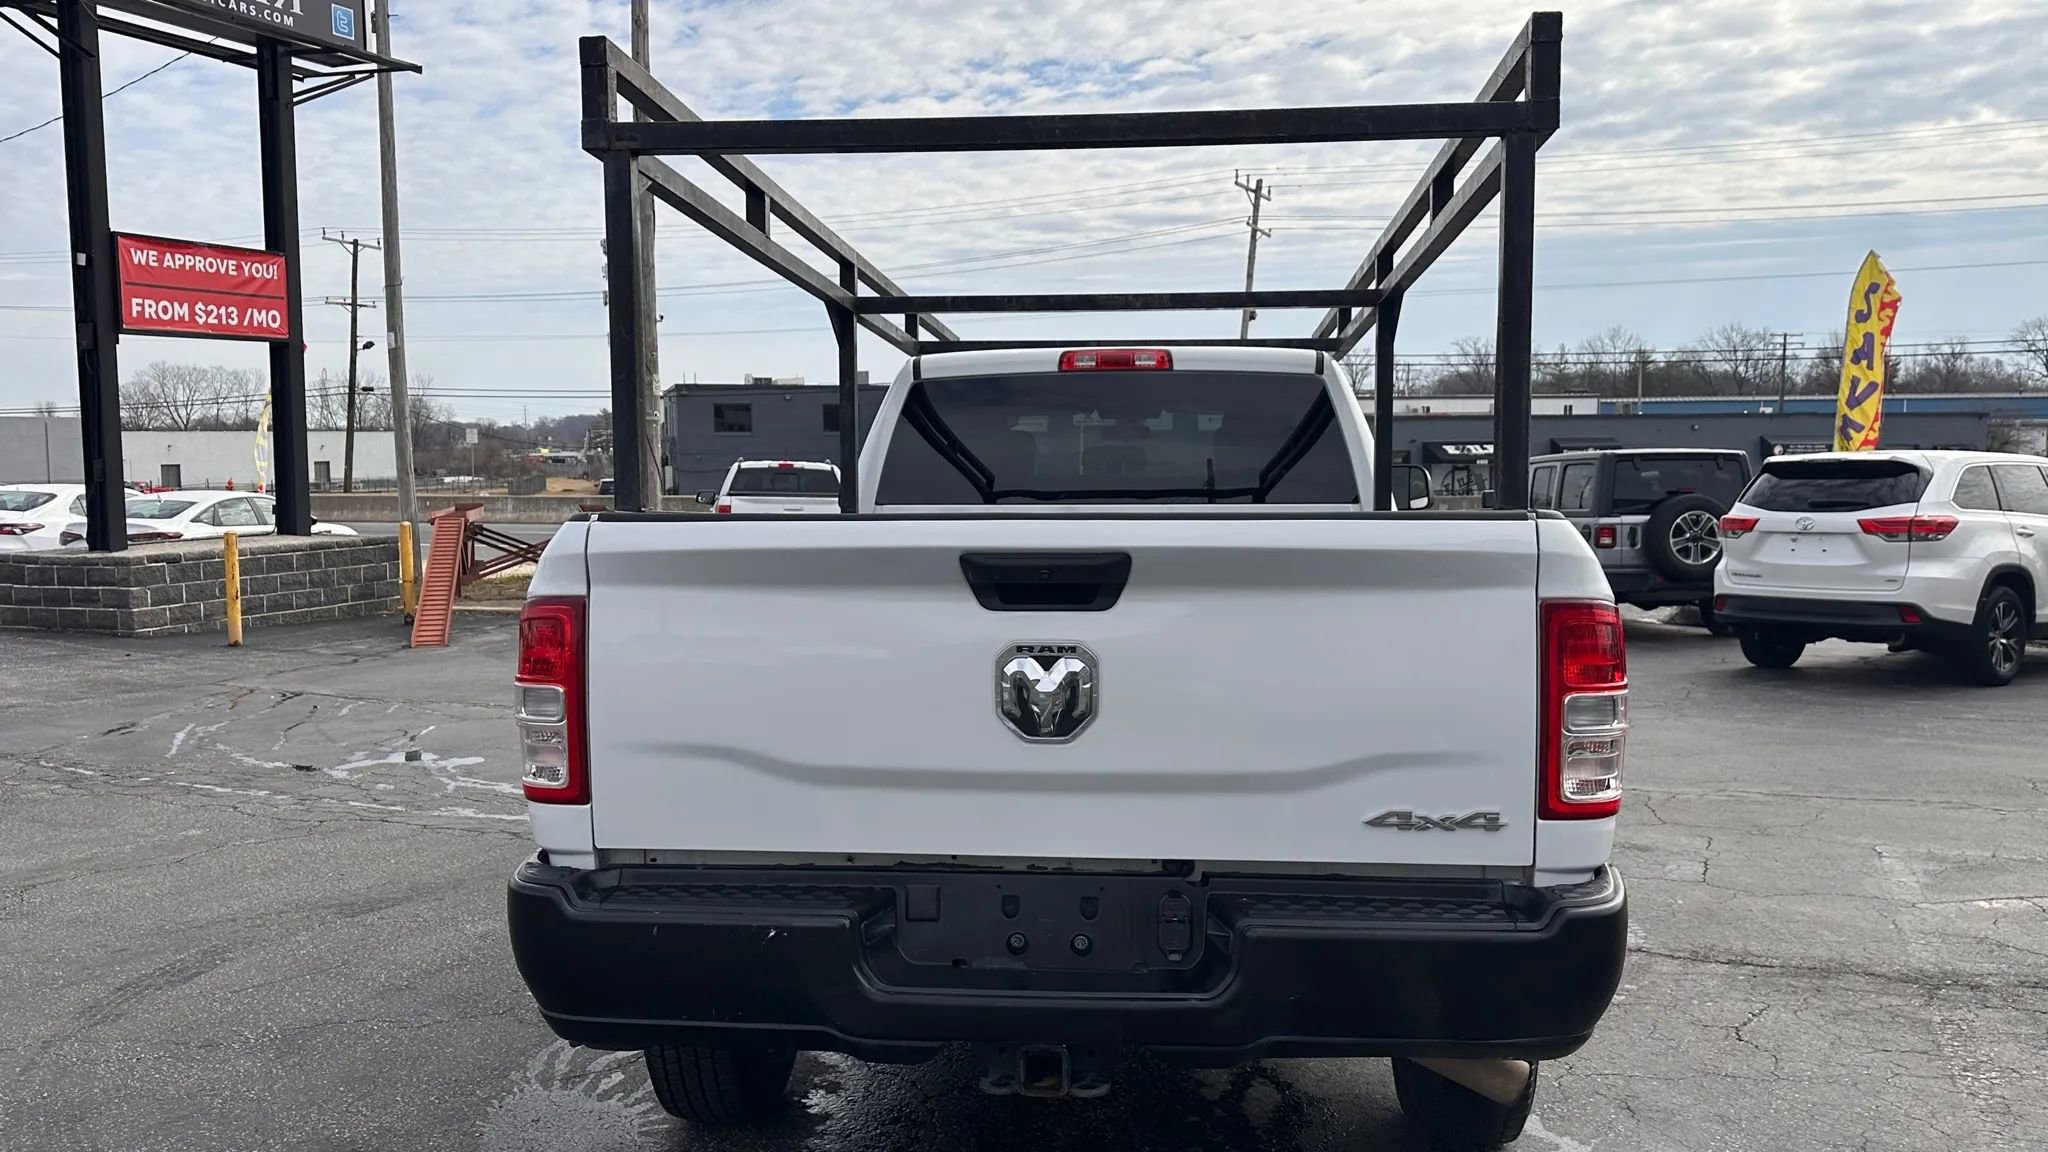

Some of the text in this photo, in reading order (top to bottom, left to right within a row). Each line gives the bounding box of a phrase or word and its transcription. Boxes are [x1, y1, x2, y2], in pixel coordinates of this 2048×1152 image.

[130, 248, 278, 280] WE APPROVE YOU!
[131, 298, 281, 329] FROM $213 /MO
[1015, 645, 1077, 654] RAM
[1361, 809, 1509, 832] 4x4
